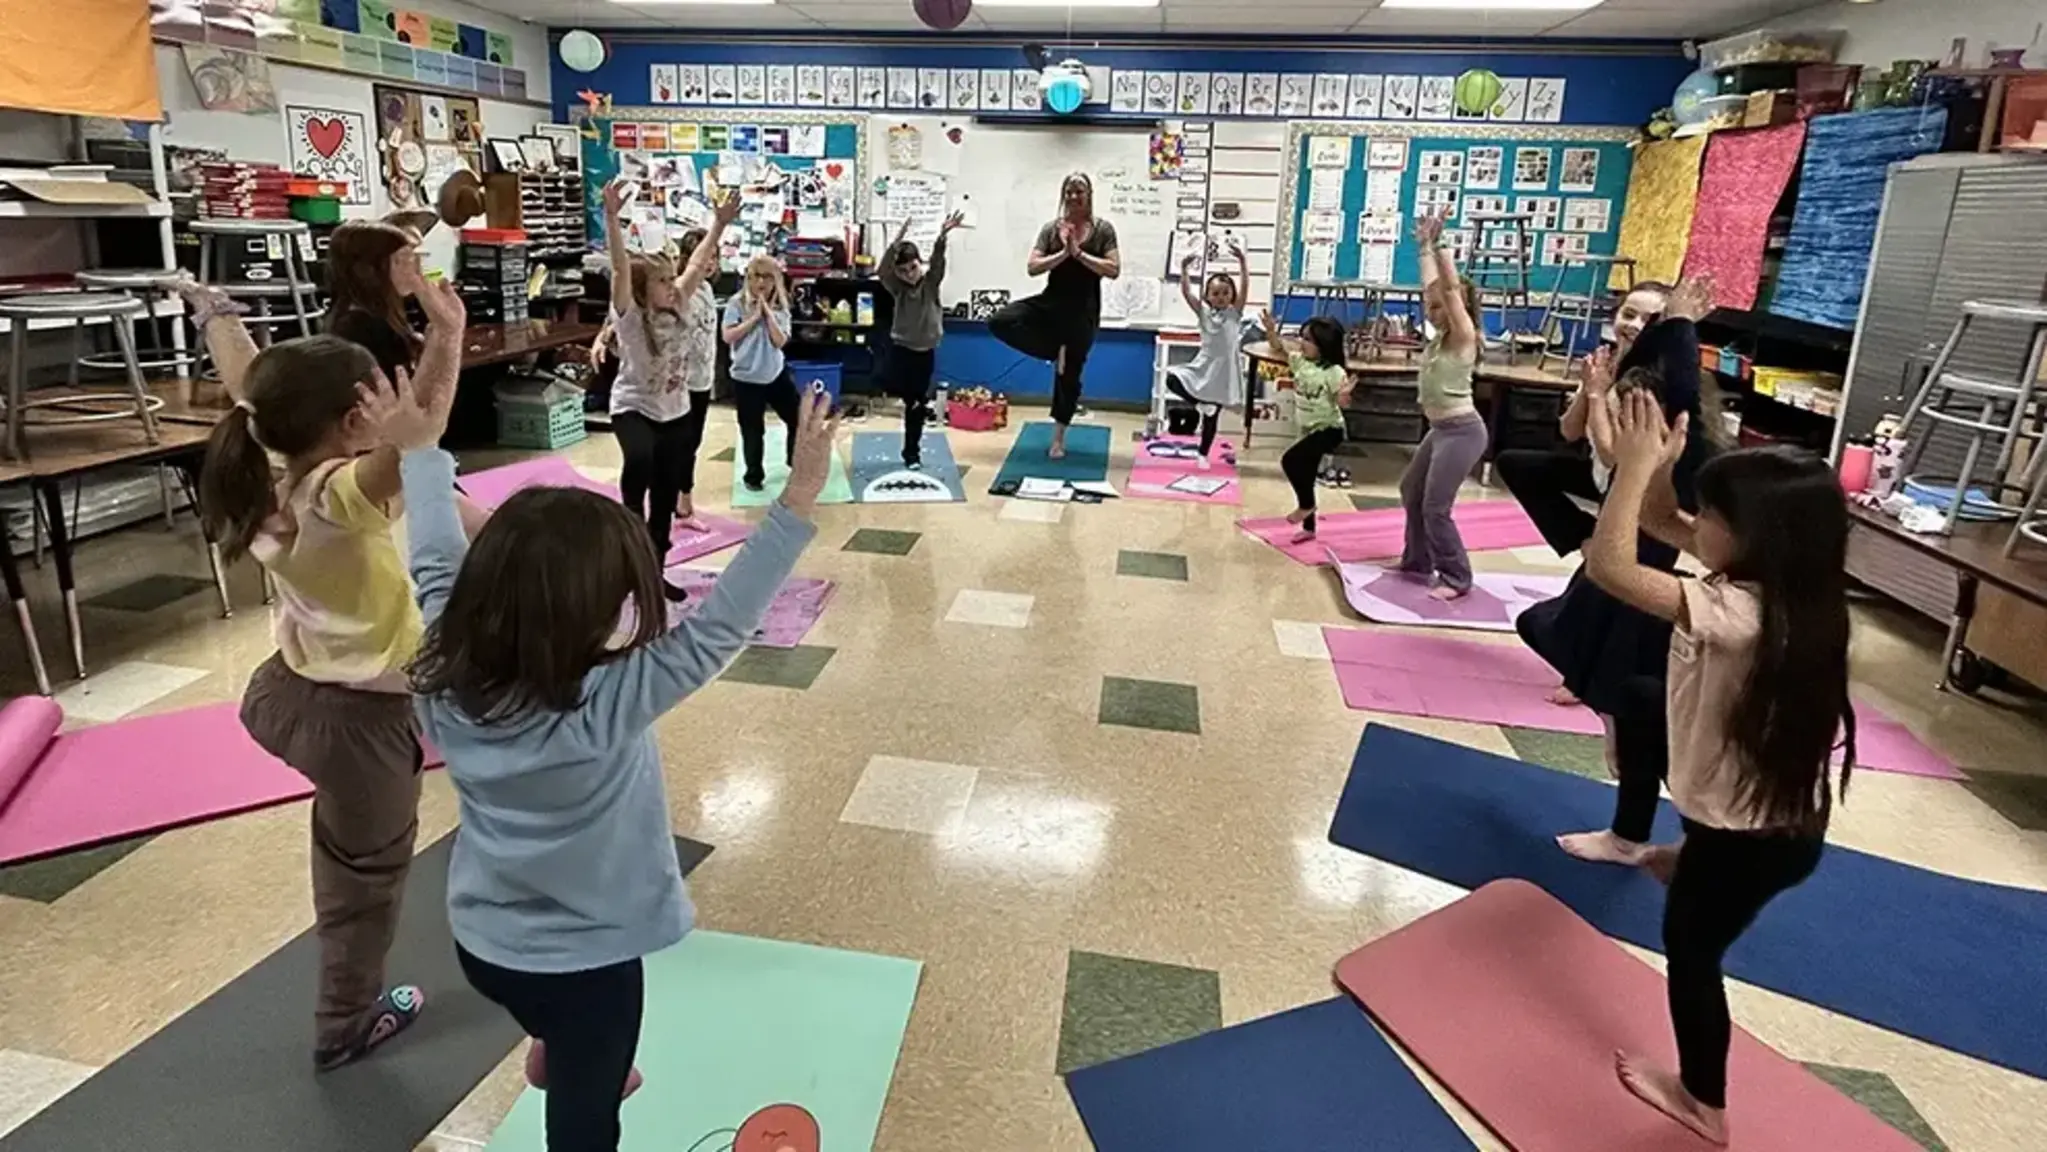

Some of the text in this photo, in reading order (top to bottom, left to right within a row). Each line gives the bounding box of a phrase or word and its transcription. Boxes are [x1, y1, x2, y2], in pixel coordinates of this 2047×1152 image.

[655, 68, 673, 86] Aa
[684, 68, 701, 85] Bb
[712, 68, 729, 86] Cc
[742, 69, 760, 86] Dd
[772, 69, 789, 87] Ee
[802, 70, 820, 87] Ff
[860, 72, 880, 89] Hh
[954, 72, 974, 90] Kk
[1116, 75, 1138, 93] Nn
[1147, 75, 1173, 94] Oo
[1251, 77, 1271, 95] Rr
[1286, 77, 1305, 97] Ss
[1321, 78, 1337, 96] Tt
[1353, 79, 1376, 98] Uu
[1391, 79, 1413, 98] Vv
[1423, 81, 1451, 99] Ww
[1534, 82, 1557, 101] Zz
